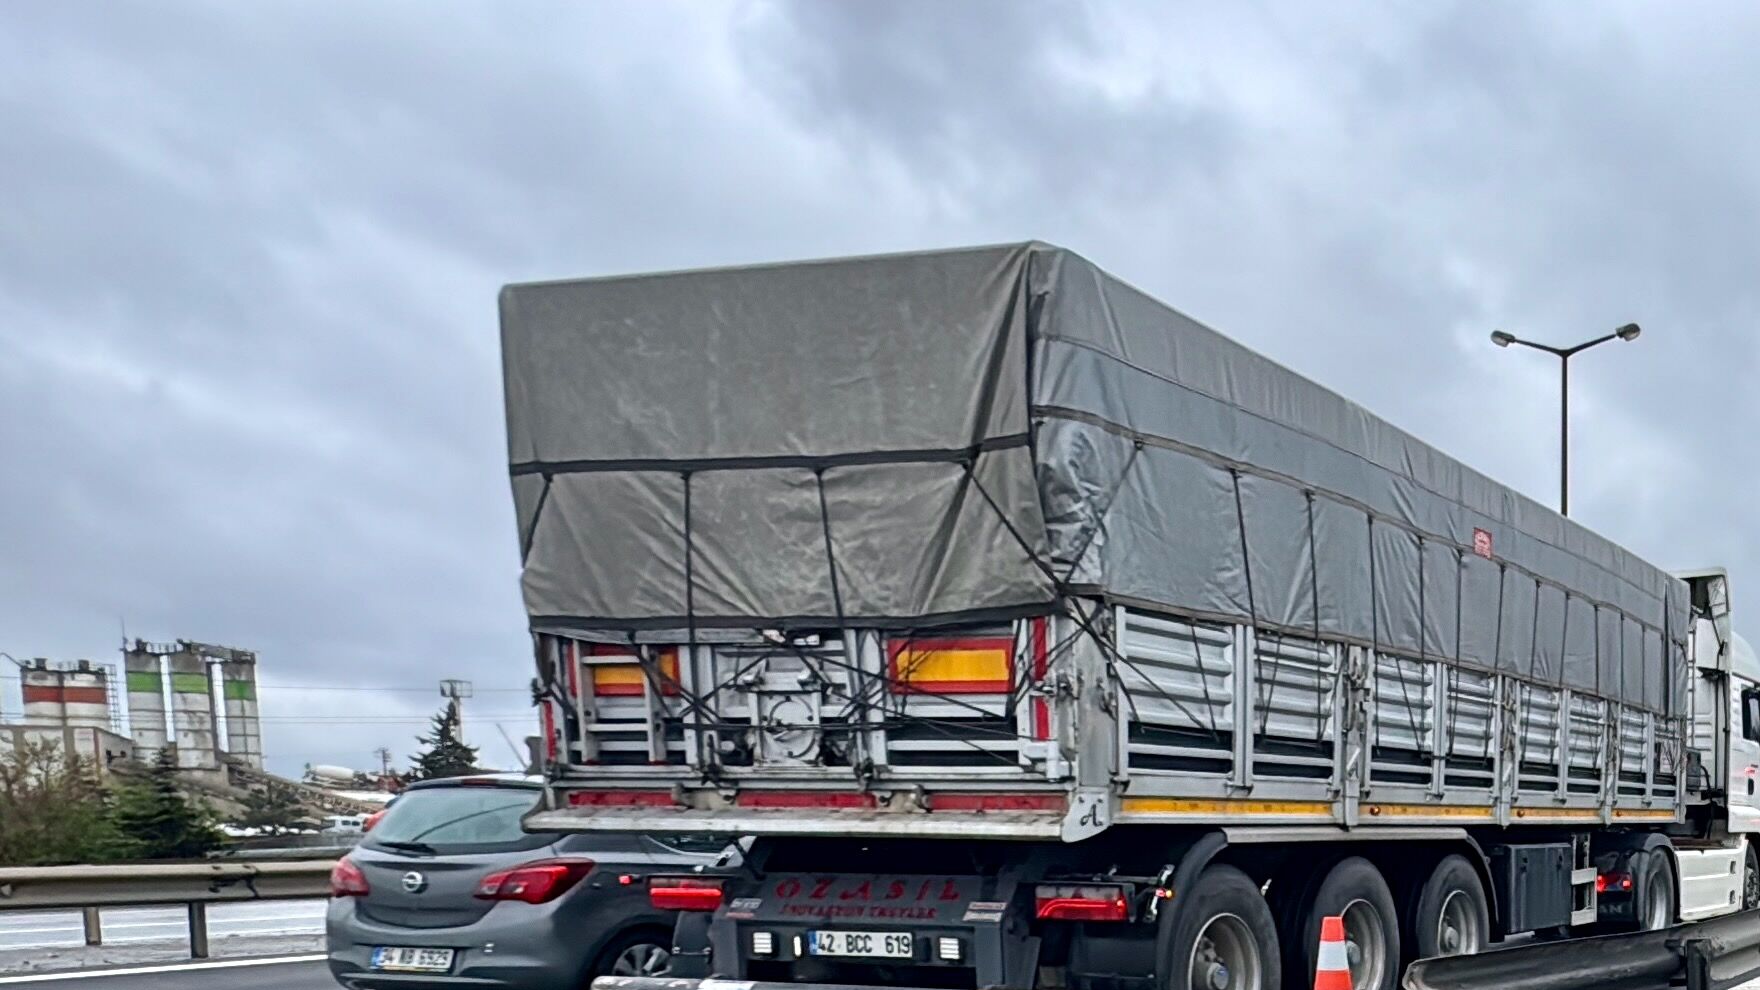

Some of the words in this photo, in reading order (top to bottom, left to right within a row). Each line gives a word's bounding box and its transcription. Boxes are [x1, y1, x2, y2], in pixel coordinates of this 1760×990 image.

[818, 933, 836, 953] 42
[845, 934, 873, 953] BCC
[885, 935, 910, 954] 619
